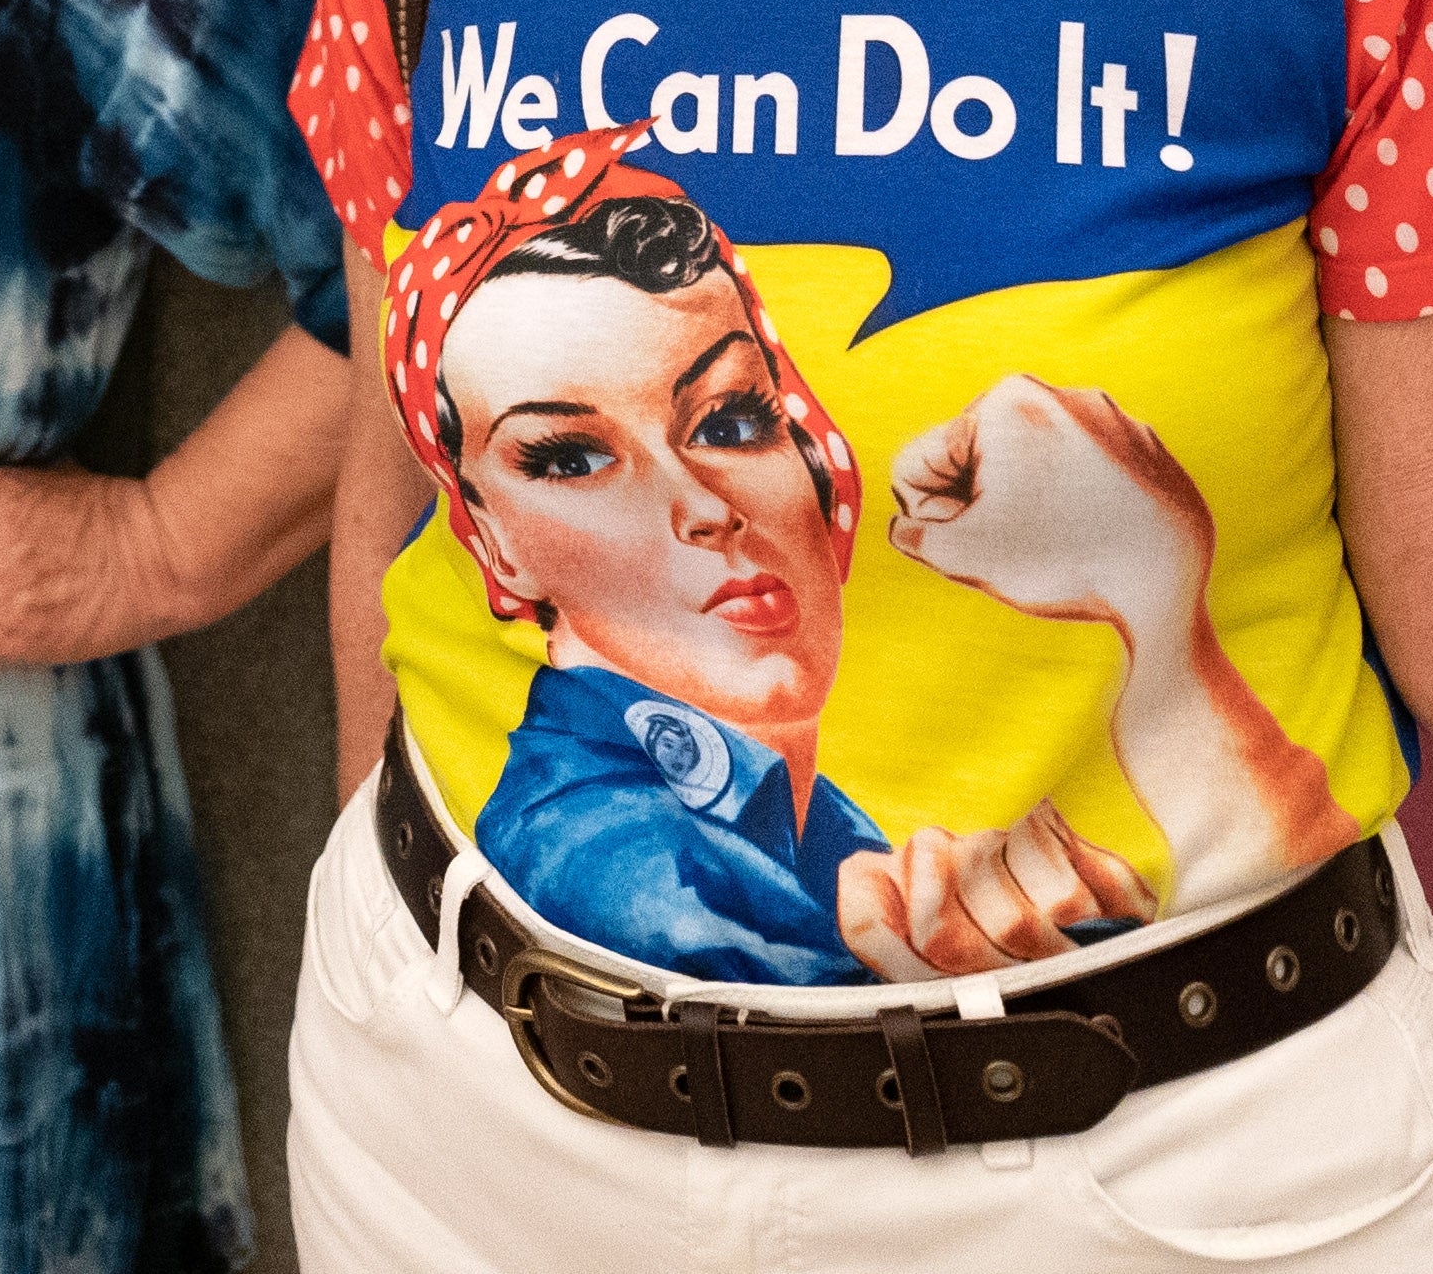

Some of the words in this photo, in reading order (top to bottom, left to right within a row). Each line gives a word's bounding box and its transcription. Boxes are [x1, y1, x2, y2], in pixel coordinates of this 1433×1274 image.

[434, 20, 560, 153] We
[579, 11, 800, 156] Can
[833, 12, 1019, 162] Do
[1055, 20, 1198, 173] It!
